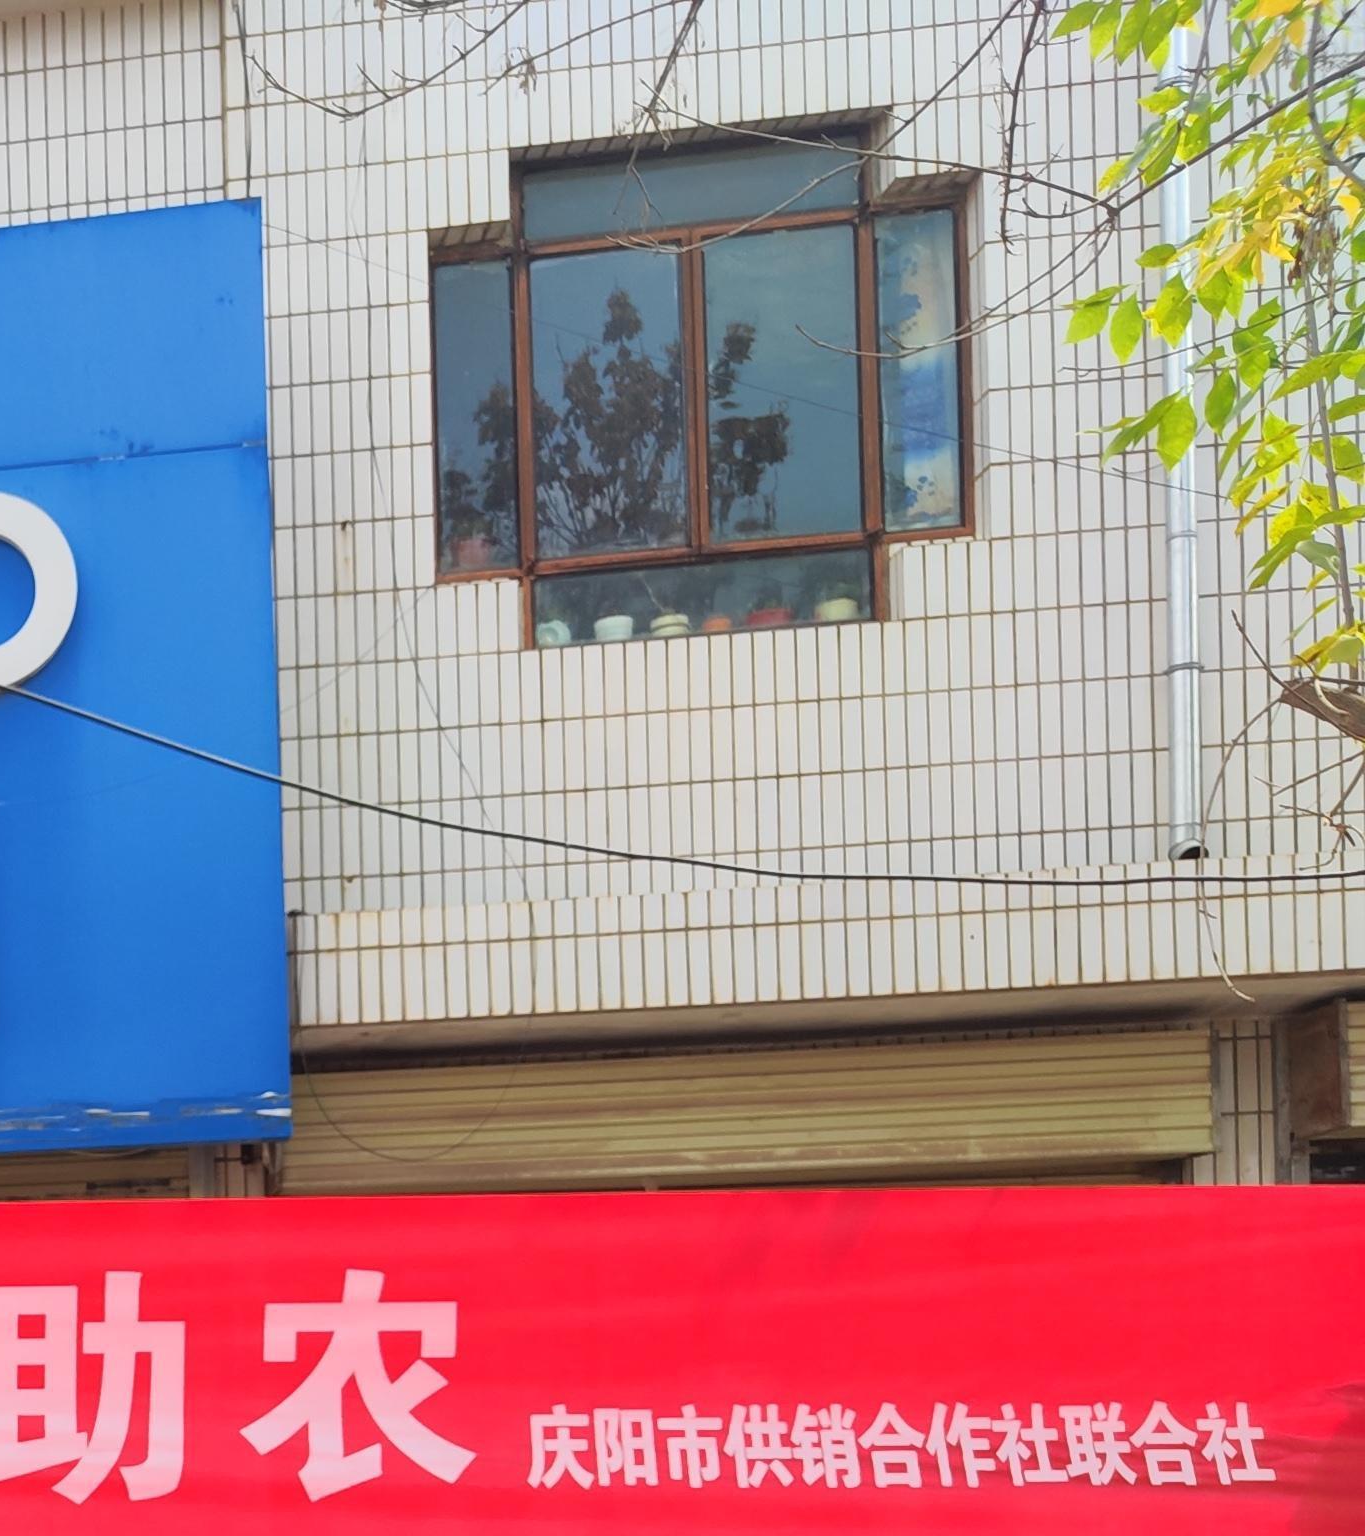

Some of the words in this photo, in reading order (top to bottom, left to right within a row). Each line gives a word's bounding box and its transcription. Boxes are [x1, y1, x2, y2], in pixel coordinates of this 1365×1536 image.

[526, 1401, 1278, 1490] 庆阳市供销合作社联合社
